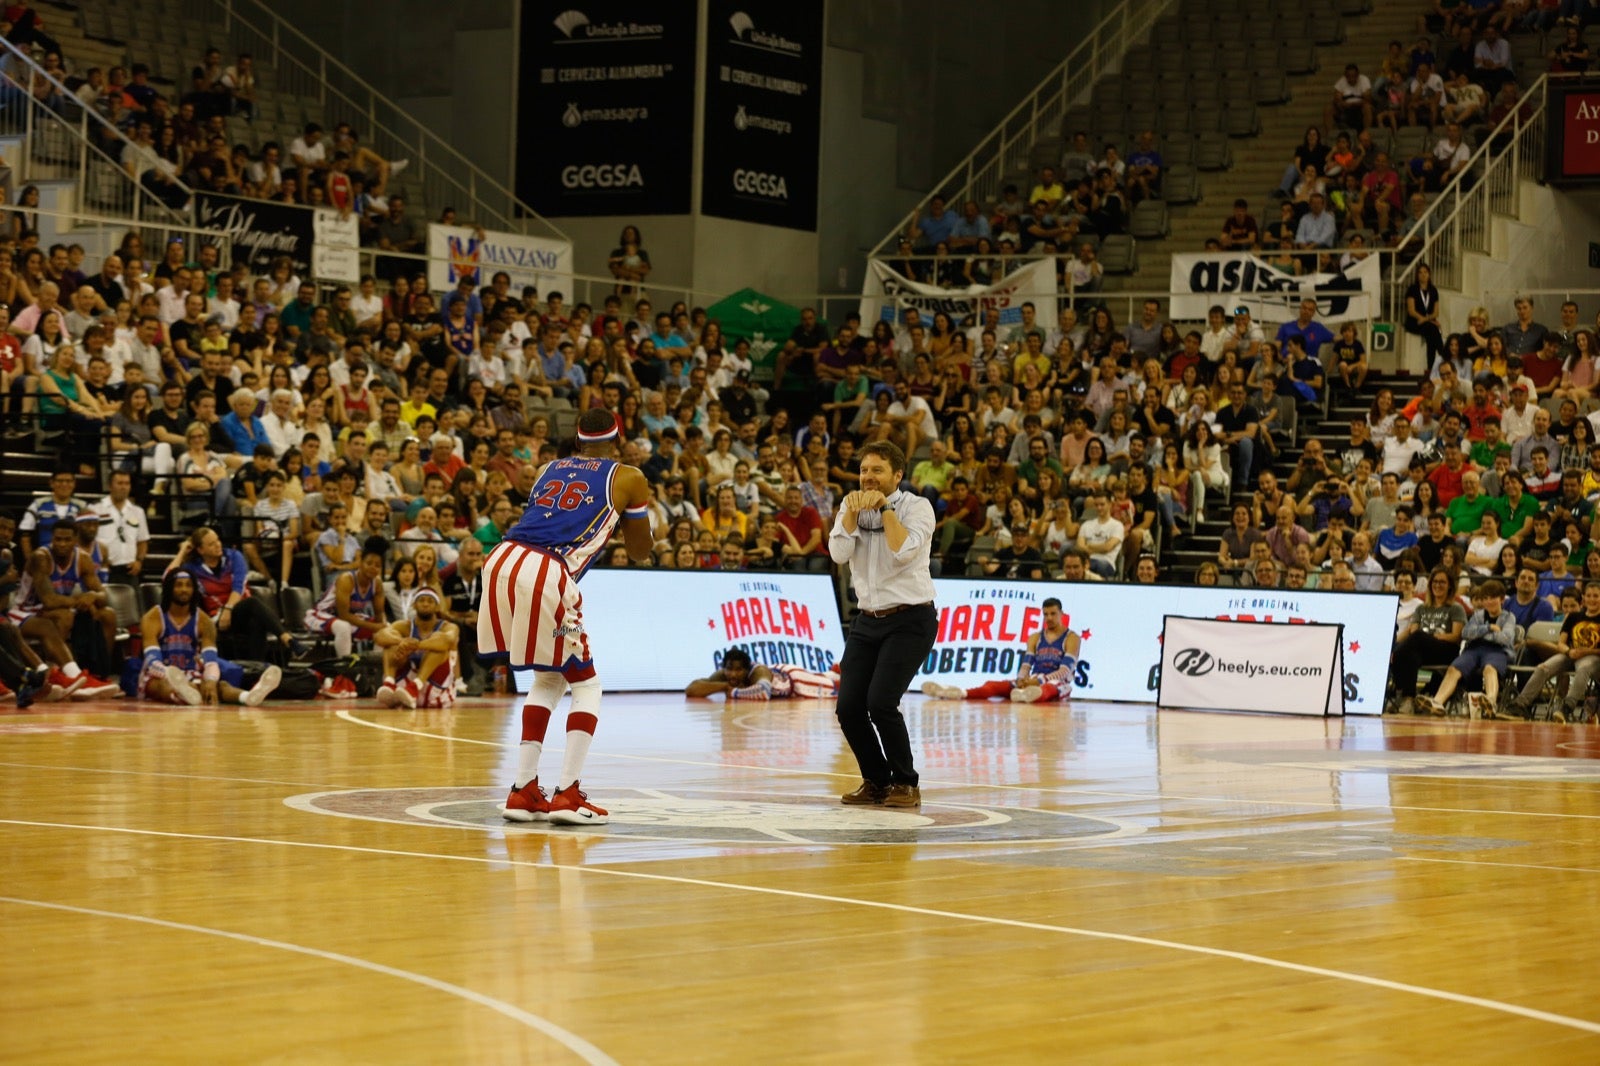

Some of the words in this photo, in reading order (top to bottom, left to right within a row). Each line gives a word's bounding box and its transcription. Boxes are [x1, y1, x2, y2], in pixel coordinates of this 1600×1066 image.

[585, 21, 627, 39] Unicaja
[629, 22, 664, 36] Banco
[750, 30, 778, 50] Unicaja
[779, 36, 802, 53] Banco
[608, 64, 665, 81] ALHAMBRA
[582, 107, 649, 124] emasagra
[747, 114, 792, 135] emasagra
[484, 243, 557, 270] MANZANO
[1373, 331, 1388, 351] D
[535, 479, 590, 511] 26
[969, 589, 985, 599] THE
[990, 588, 1035, 602] ORIGINAL
[1251, 598, 1300, 613] ORIGINAL
[721, 597, 814, 641] HARLEM
[1217, 658, 1323, 678] heelys.eu.com
